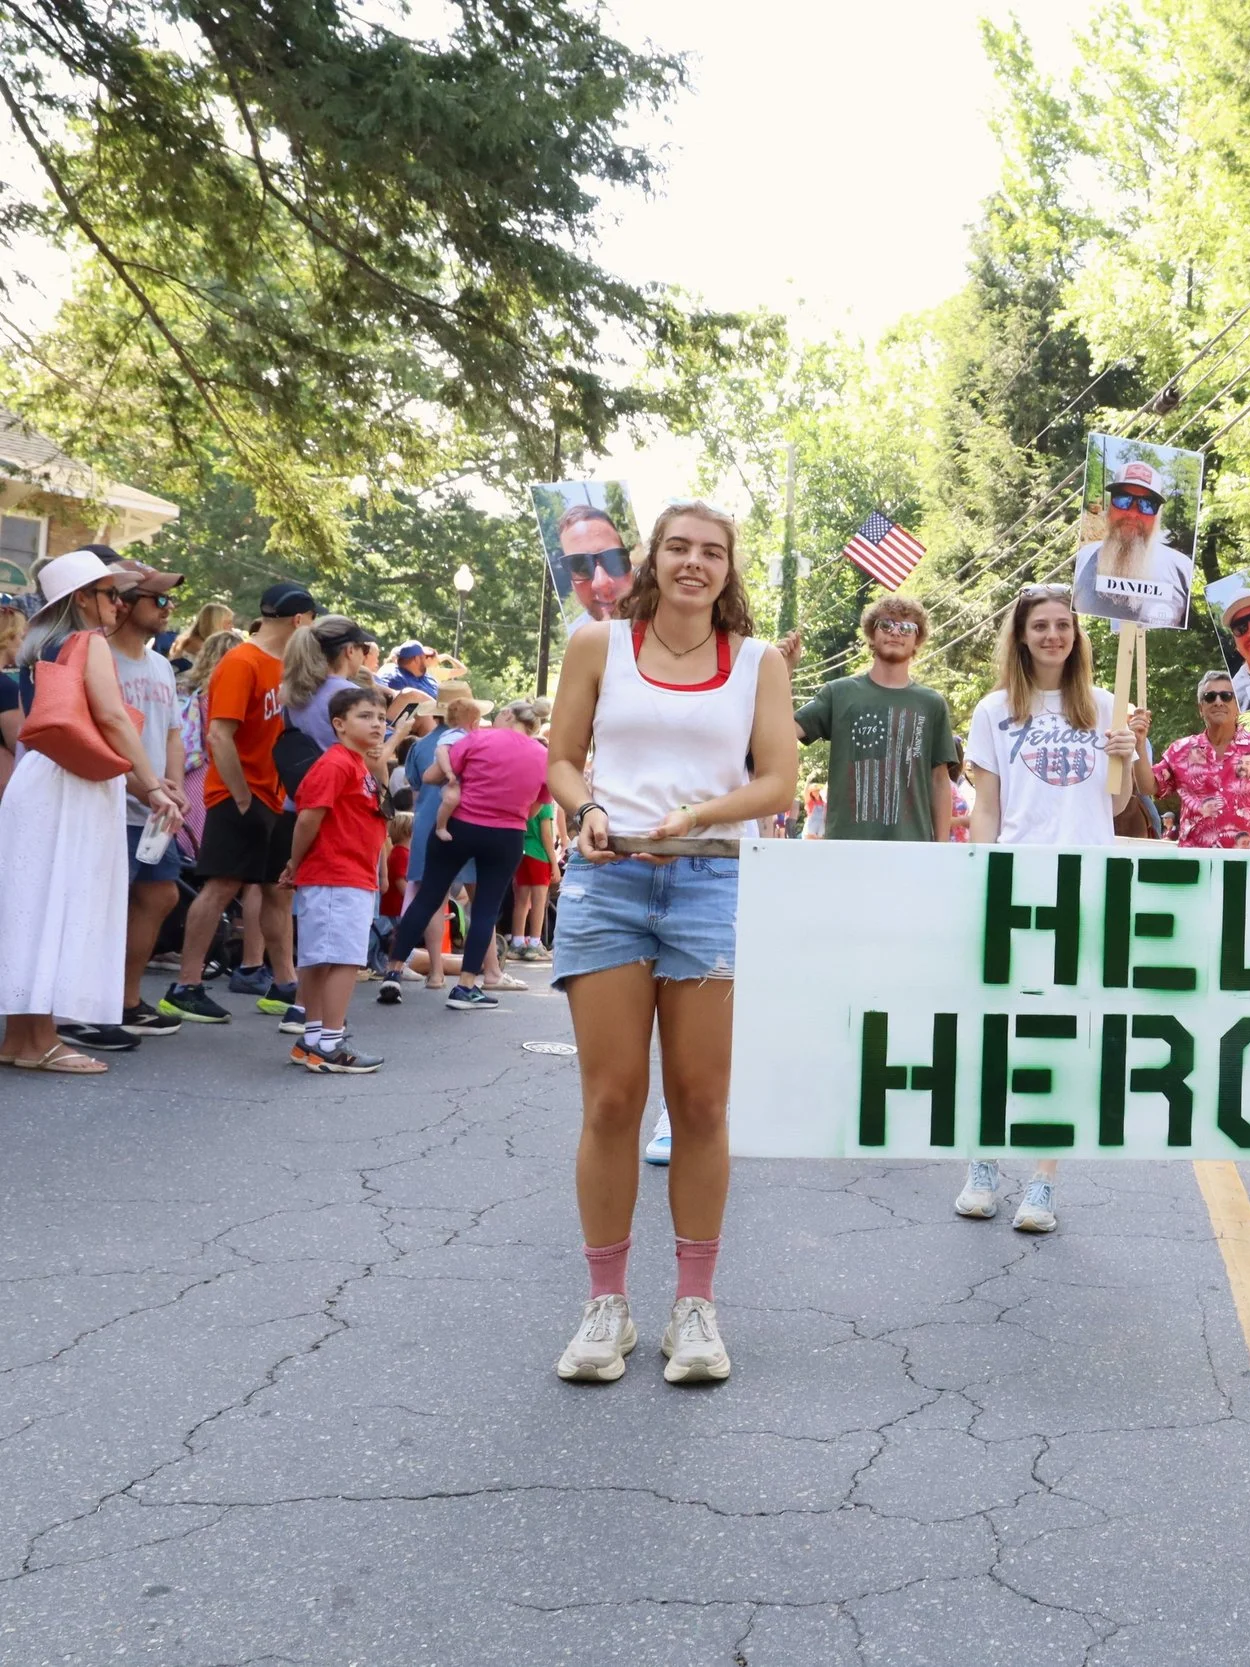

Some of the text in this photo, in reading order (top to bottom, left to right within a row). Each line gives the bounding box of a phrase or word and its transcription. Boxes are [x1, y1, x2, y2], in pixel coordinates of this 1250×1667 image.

[1107, 579, 1163, 597] DANIEL
[264, 683, 285, 720] CL
[859, 725, 878, 736] 1776
[999, 714, 1105, 764] Fender
